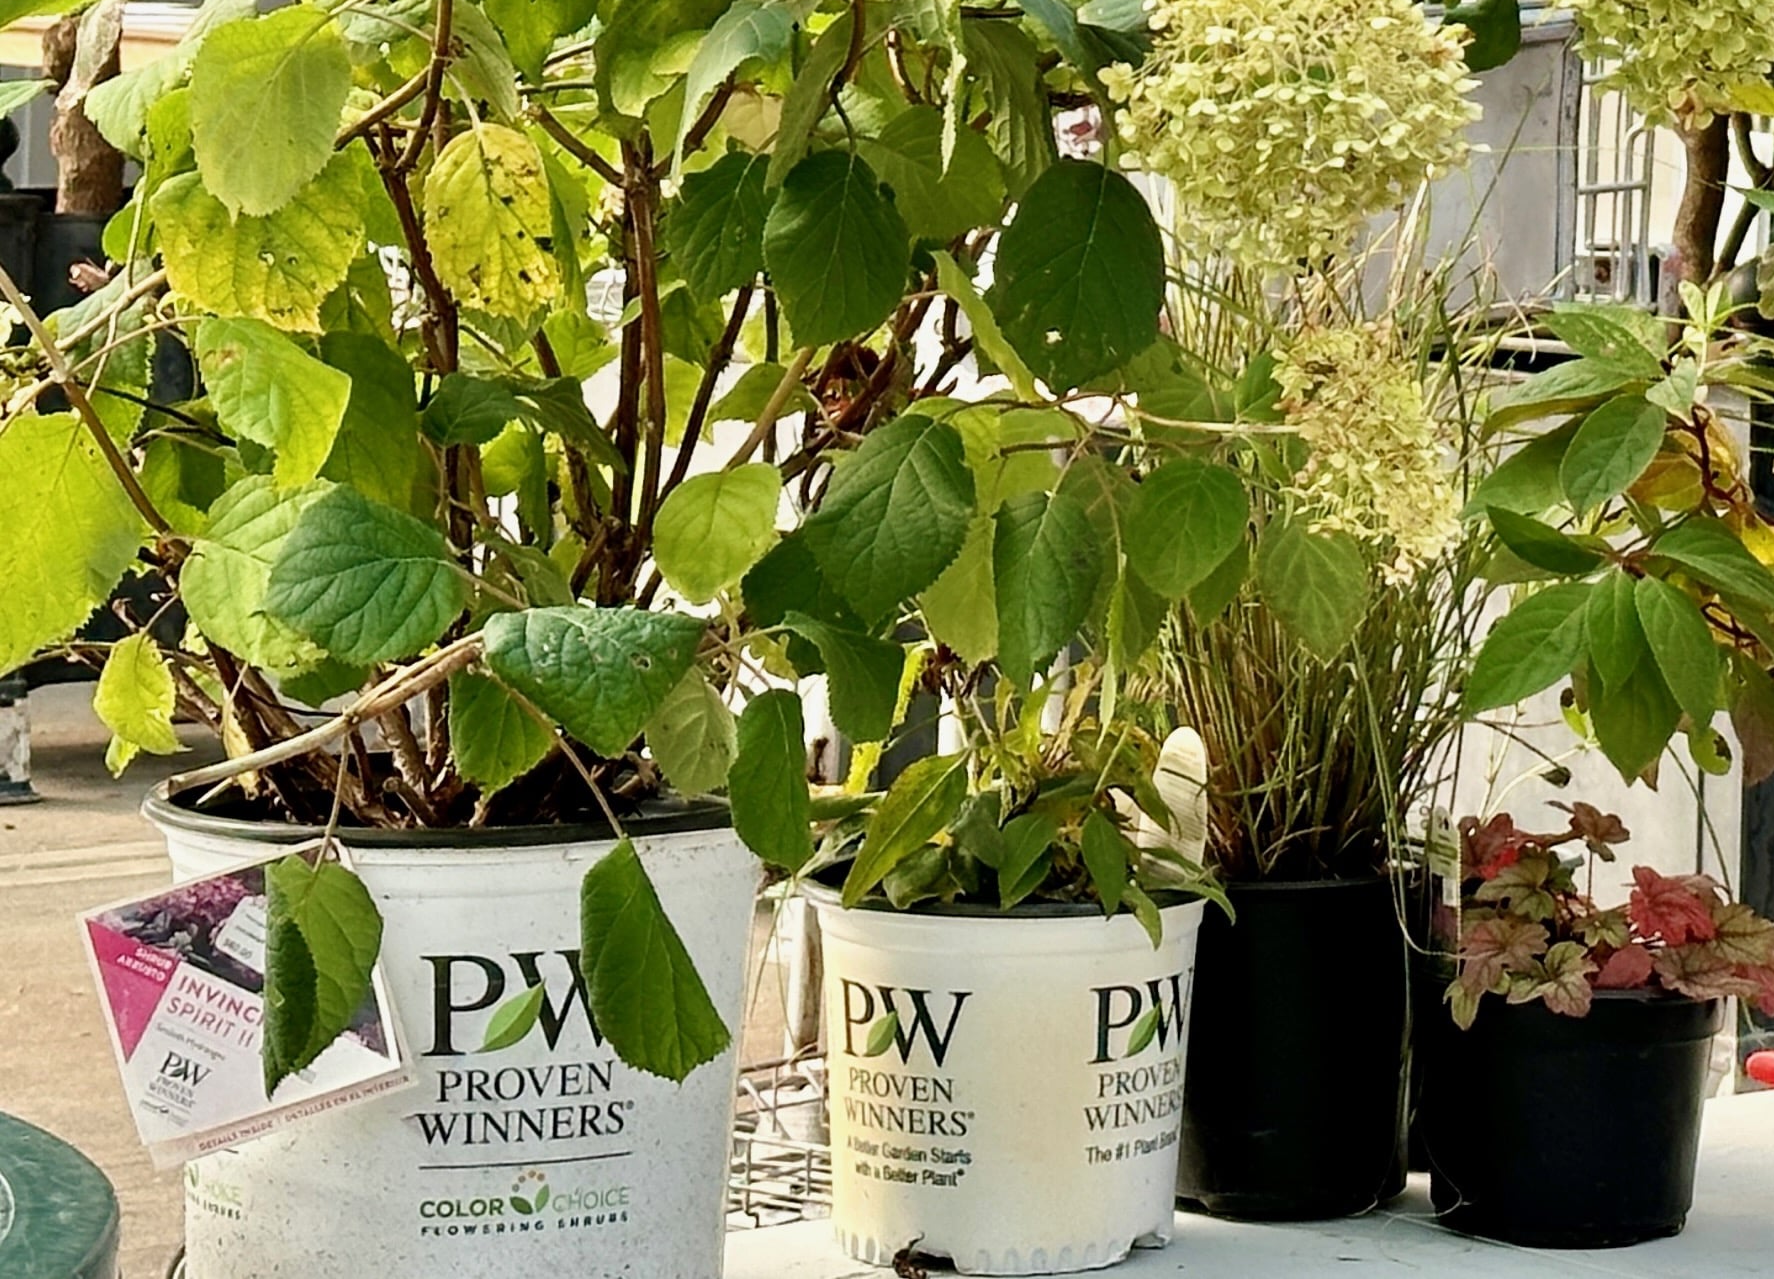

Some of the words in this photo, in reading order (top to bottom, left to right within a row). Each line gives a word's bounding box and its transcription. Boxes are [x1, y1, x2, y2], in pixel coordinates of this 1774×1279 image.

[135, 948, 173, 970] SHRUB
[167, 997, 236, 1036] SPIRIT
[238, 1031, 255, 1048] II
[840, 977, 973, 1068] PW
[1087, 966, 1194, 1065] PW
[160, 1051, 213, 1087] PW
[436, 1060, 615, 1103] PROVEN
[849, 1067, 954, 1103] PROVEN
[1098, 1056, 1182, 1098] PROVEN
[882, 1142, 927, 1162] Garden
[930, 1147, 973, 1165] Starts
[1085, 1145, 1112, 1165] The
[1115, 1141, 1130, 1160] #1
[883, 1165, 918, 1184] Better
[420, 1198, 504, 1218] COLOR
[553, 1187, 632, 1213] CHOICE
[421, 1220, 545, 1236] FLOWERING
[558, 1211, 629, 1230] SHRUBS
